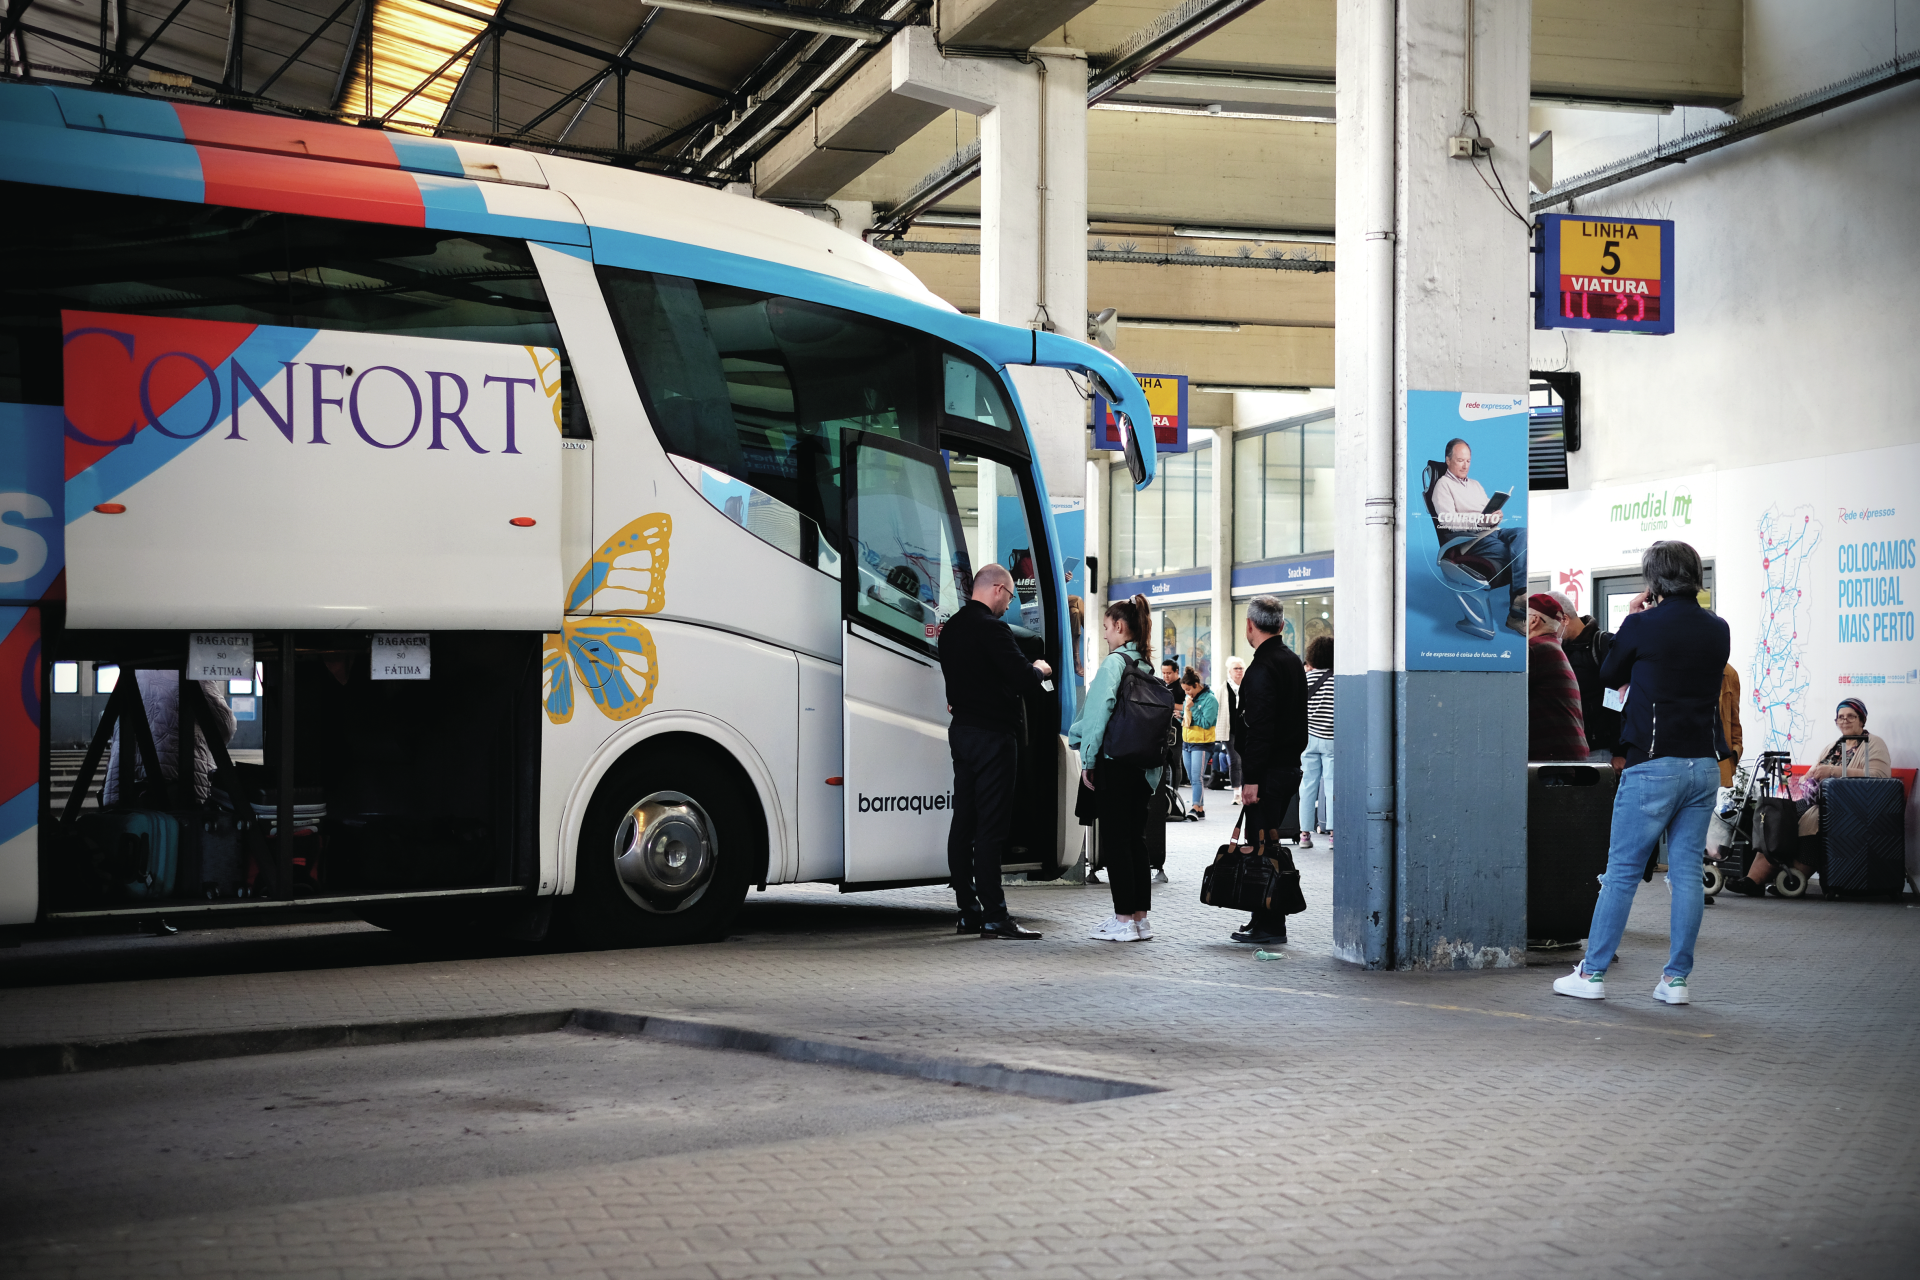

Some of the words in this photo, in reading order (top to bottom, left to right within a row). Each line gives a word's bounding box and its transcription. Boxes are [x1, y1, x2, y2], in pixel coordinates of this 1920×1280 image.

[1582, 222, 1638, 240] LINHA
[1600, 240, 1621, 276] 5
[1571, 277, 1649, 294] VIATURA
[63, 326, 536, 454] CONFORT
[1481, 402, 1512, 411] expressos
[1610, 490, 1668, 522] mundial
[1672, 494, 1692, 524] mt
[1438, 512, 1500, 524] CONFORTO
[1838, 508, 1857, 524] Rede
[1640, 518, 1668, 532] turismo
[1838, 538, 1916, 574] COLOCAMOS
[1288, 567, 1311, 578] Snack-Bar
[1152, 583, 1170, 594] Snack-Bar
[1838, 576, 1904, 608] PORTUGAL
[1838, 613, 1870, 643] MAIS
[1874, 611, 1914, 642] PERTO
[196, 636, 249, 646] BAGAGEM
[378, 636, 427, 646] BAGAGEM
[203, 665, 242, 676] FÁTIMA
[384, 664, 421, 675] FÁTIMA
